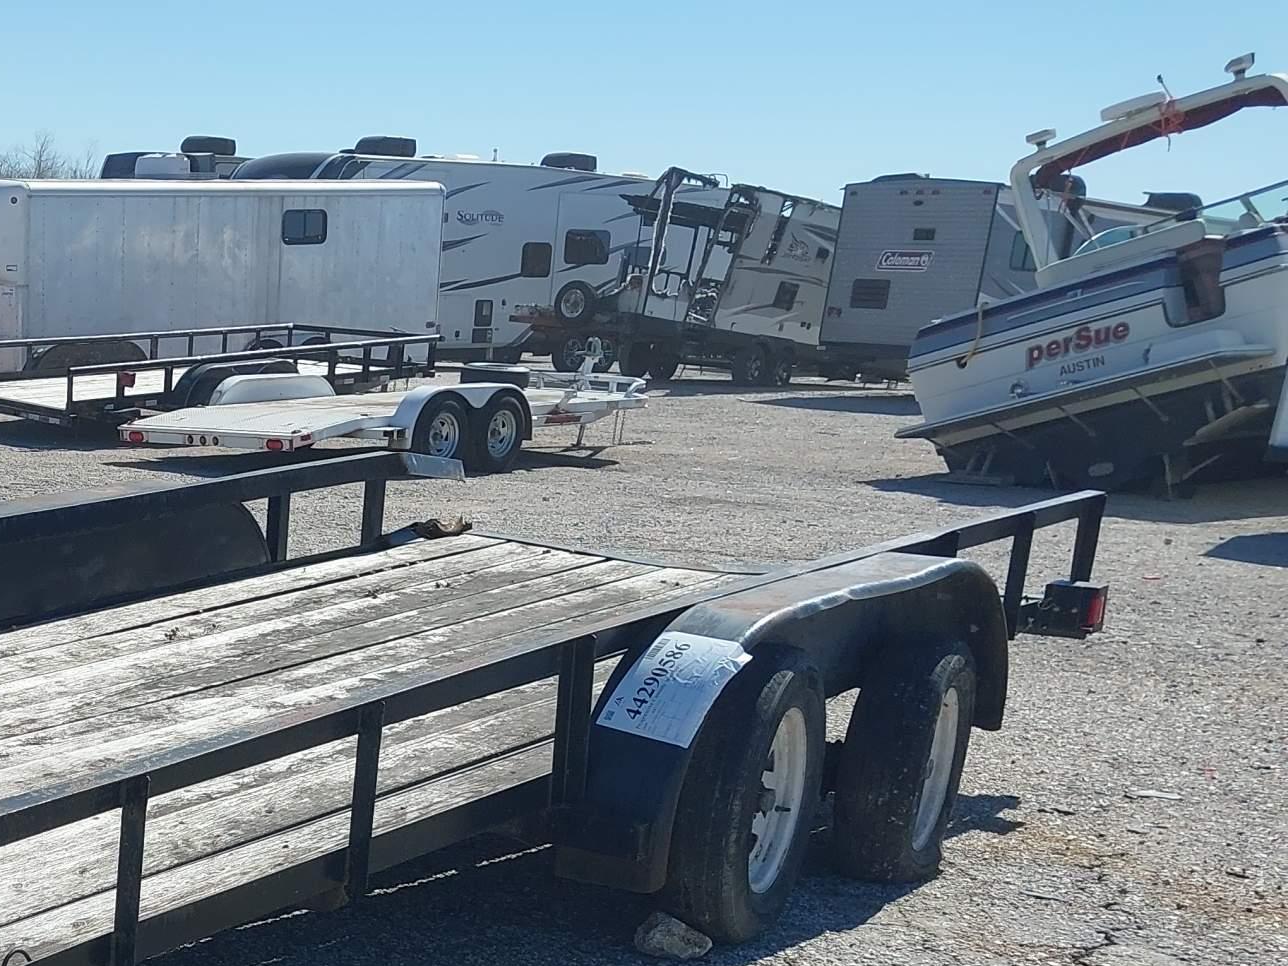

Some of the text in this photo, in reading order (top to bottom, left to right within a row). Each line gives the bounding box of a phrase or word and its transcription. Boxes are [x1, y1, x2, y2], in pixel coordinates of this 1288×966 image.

[881, 252, 921, 265] Coleman
[1025, 321, 1130, 370] perSue
[1059, 355, 1105, 376] AUSTIN
[625, 642, 691, 720] 44290586
